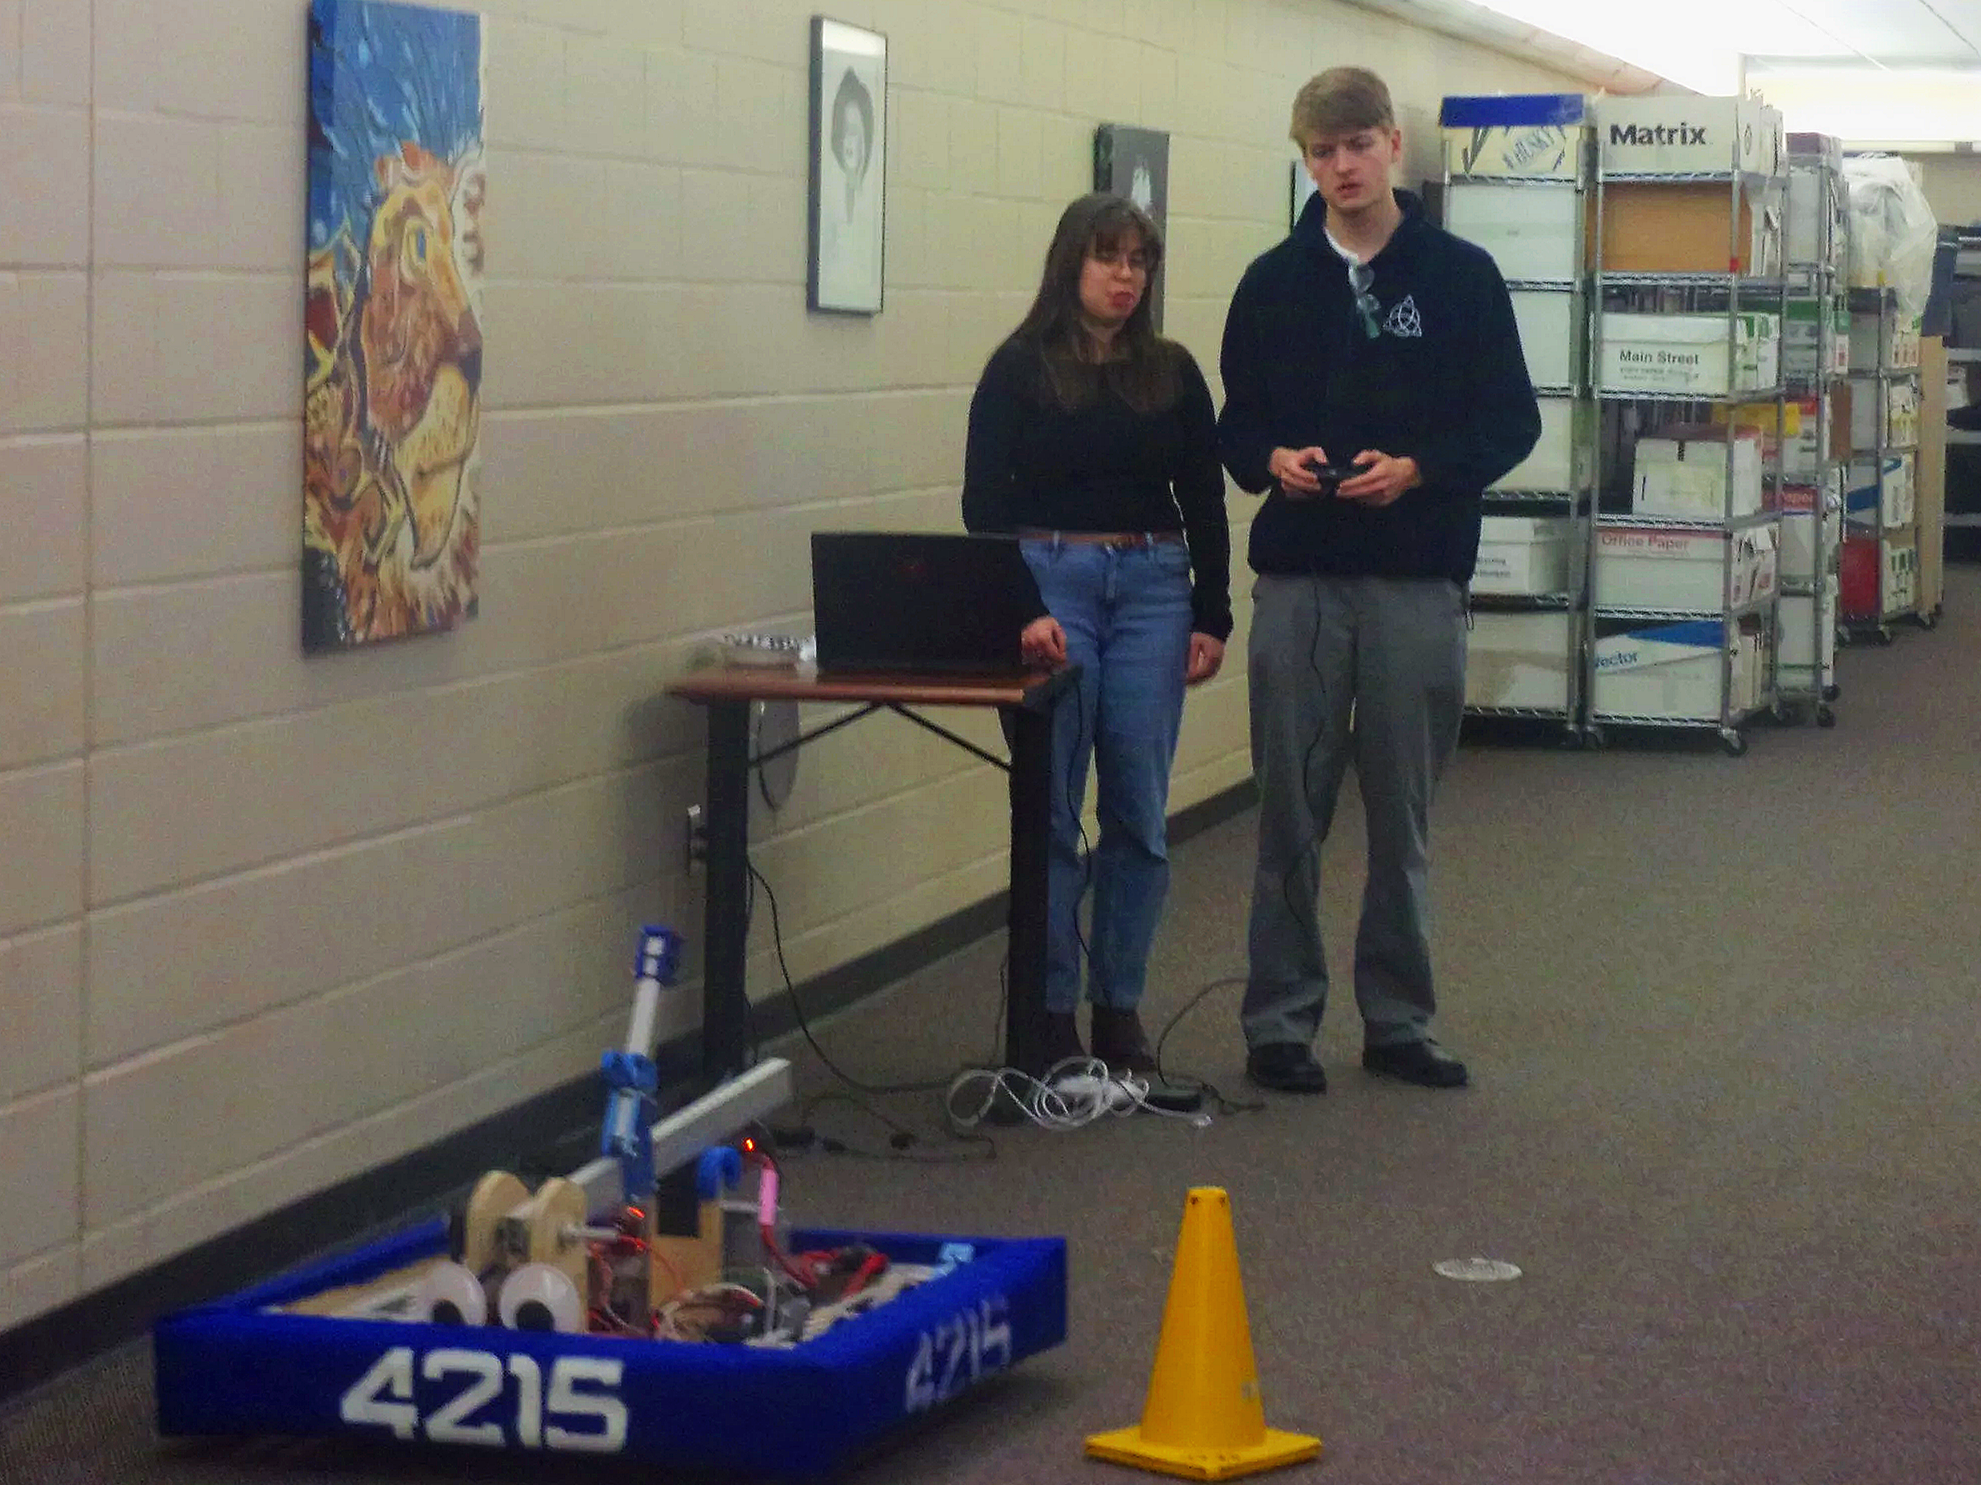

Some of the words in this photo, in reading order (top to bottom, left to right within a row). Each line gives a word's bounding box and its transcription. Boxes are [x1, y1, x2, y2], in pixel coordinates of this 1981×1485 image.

[1609, 122, 1708, 146] Matrix
[1619, 349, 1653, 363] Main
[1657, 351, 1699, 366] Street
[1601, 534, 1643, 547] Office
[1648, 535, 1690, 550] Paper
[905, 1296, 1013, 1414] 4215
[340, 1346, 630, 1451] 4215
